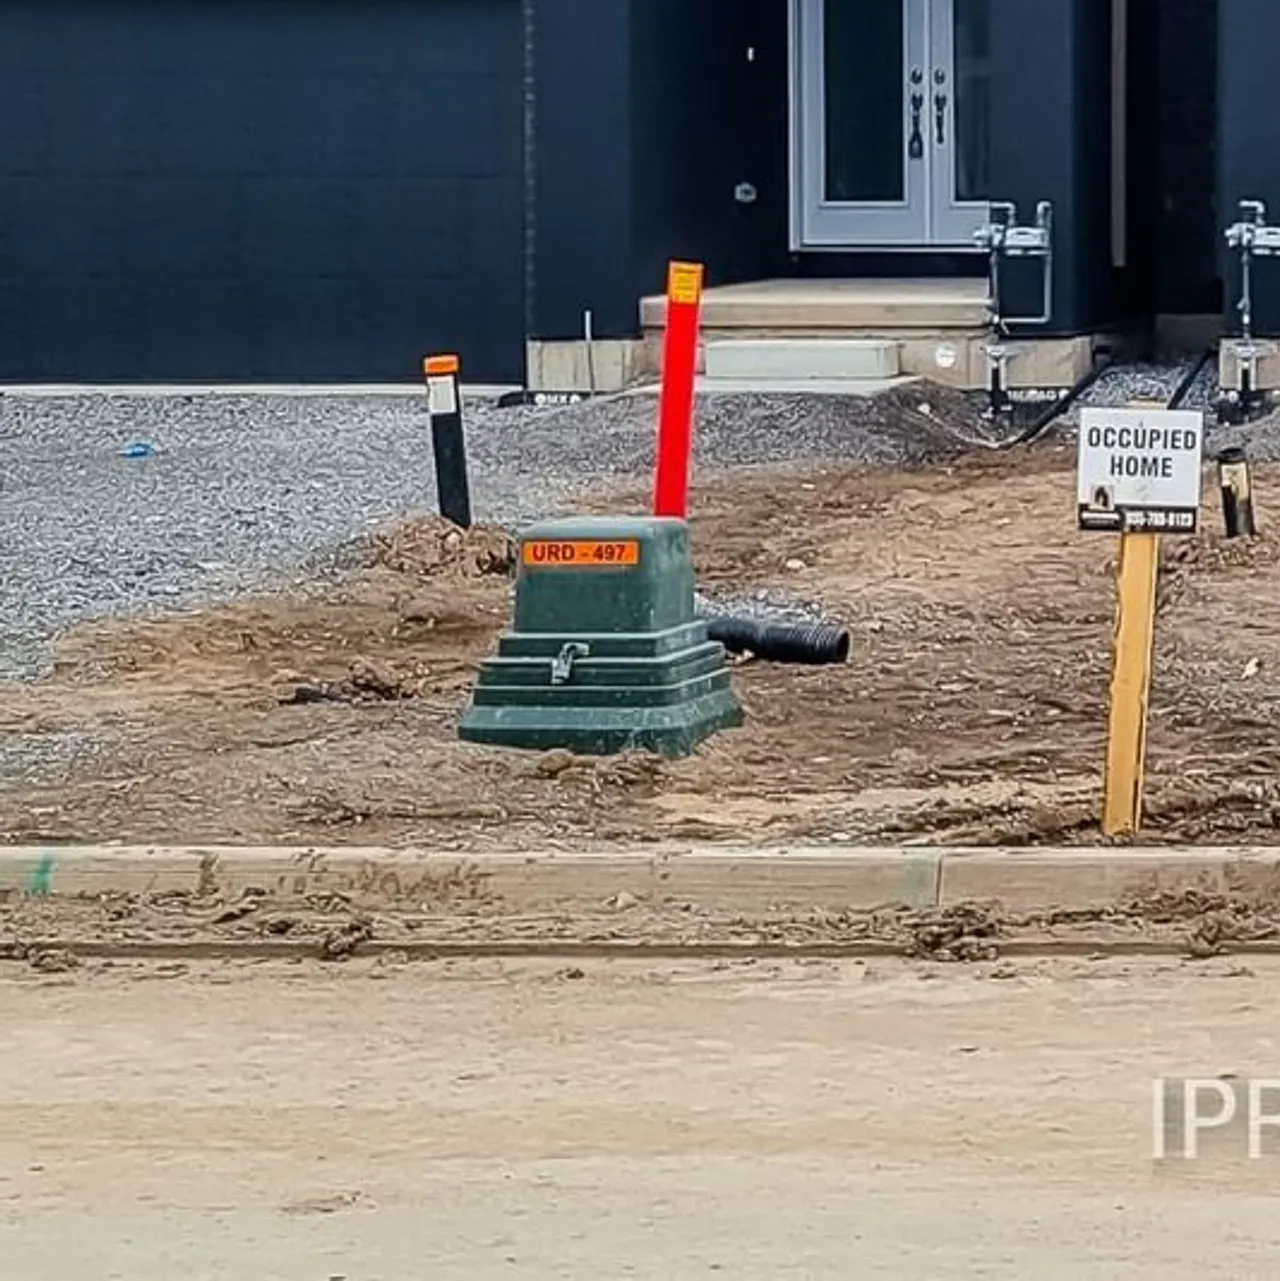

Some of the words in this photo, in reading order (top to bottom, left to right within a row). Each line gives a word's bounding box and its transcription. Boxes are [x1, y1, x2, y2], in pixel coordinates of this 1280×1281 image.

[1087, 426, 1197, 450] OCCUPIED
[1110, 455, 1173, 477] HOME
[532, 544, 575, 561] URD
[593, 544, 626, 560] 497
